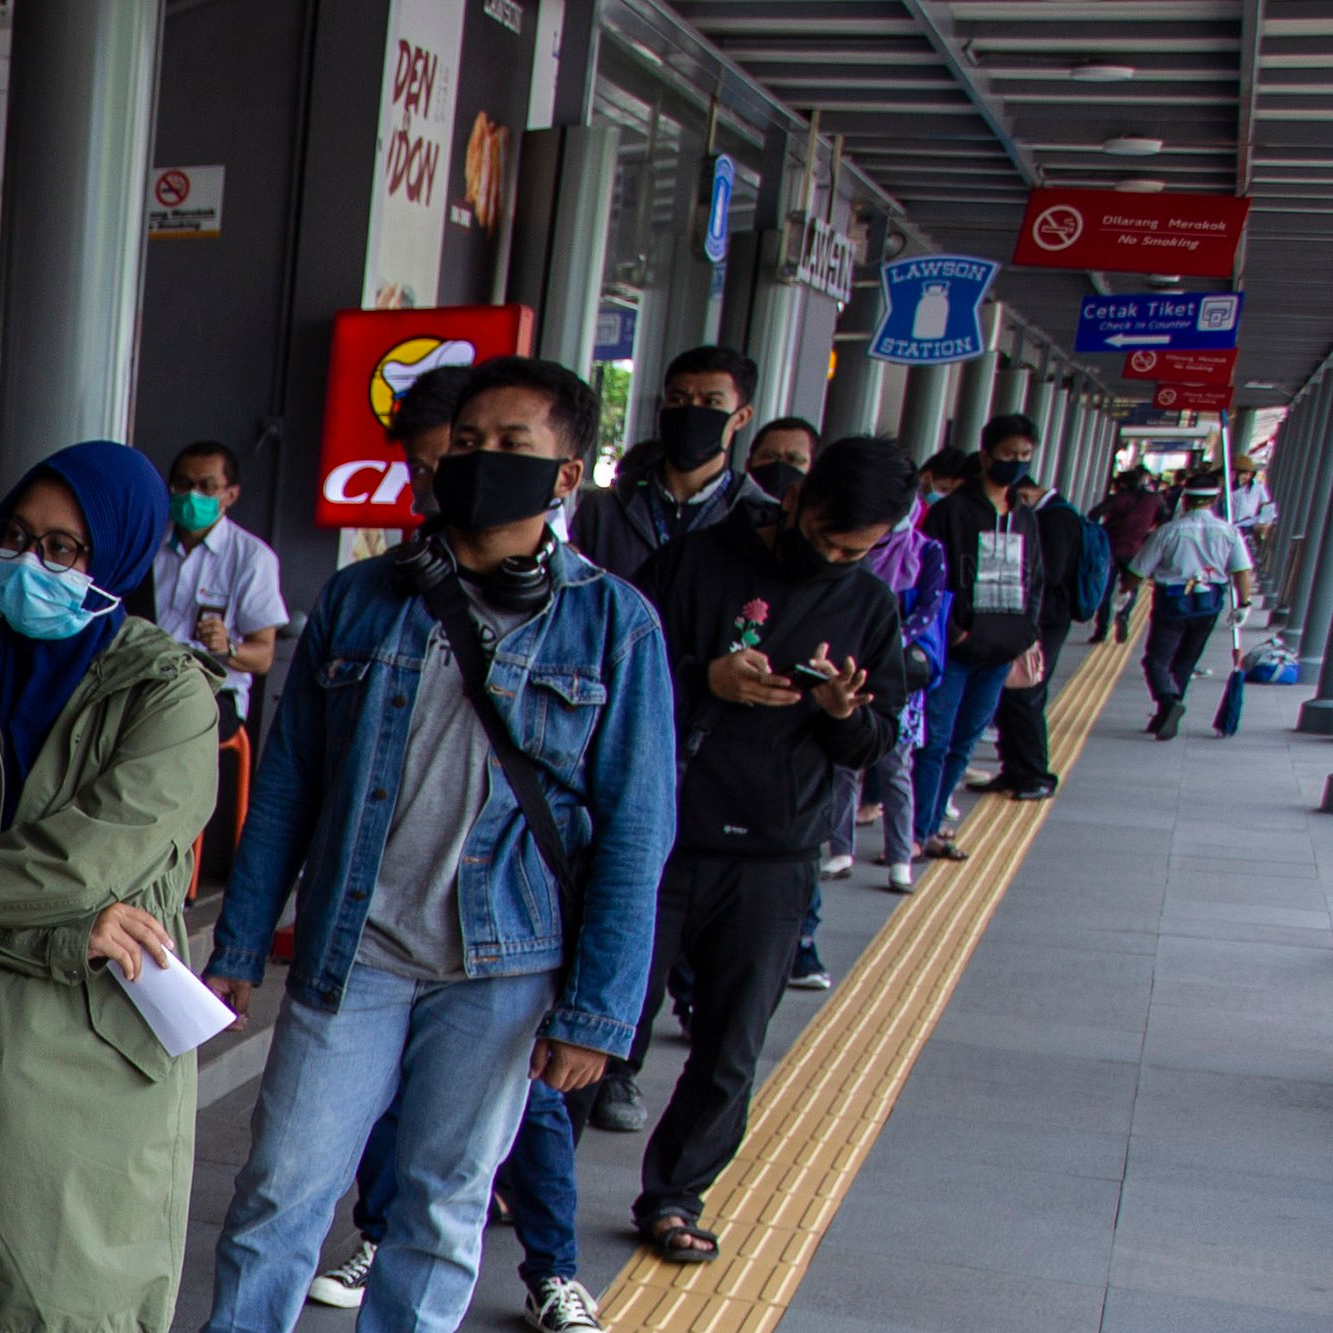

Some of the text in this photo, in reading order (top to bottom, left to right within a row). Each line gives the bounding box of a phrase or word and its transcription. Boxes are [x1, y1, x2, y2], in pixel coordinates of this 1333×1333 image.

[1101, 214, 1227, 232] Dilarang Merokok
[1116, 233, 1201, 250] No Smoking
[890, 261, 987, 283] LAWSON
[1083, 302, 1196, 319] Cetak Tiket
[1099, 320, 1132, 331] Check
[1147, 319, 1192, 331] Counter
[880, 336, 973, 358] STATION
[323, 459, 411, 504] CF
